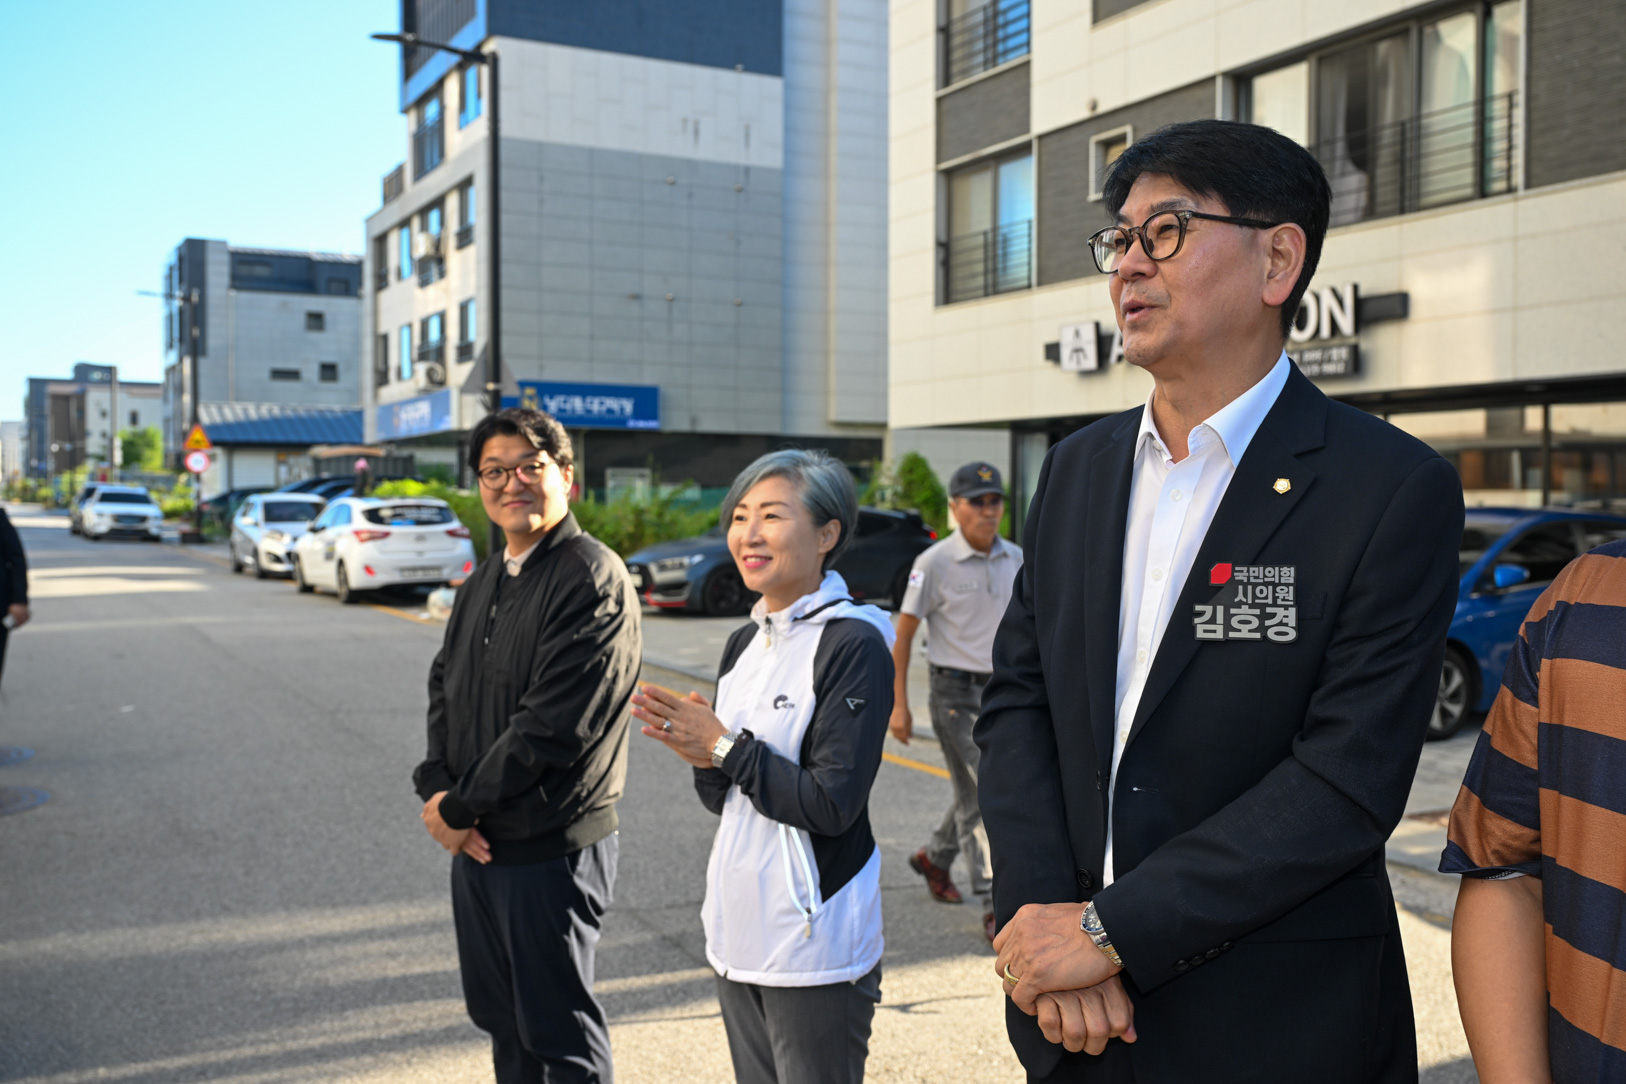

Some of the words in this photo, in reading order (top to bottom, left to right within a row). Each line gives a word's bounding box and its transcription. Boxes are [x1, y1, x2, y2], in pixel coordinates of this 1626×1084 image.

[1233, 566, 1295, 584] 국민의힘
[1234, 585, 1294, 605] 시의원
[1193, 605, 1296, 642] 김호경
